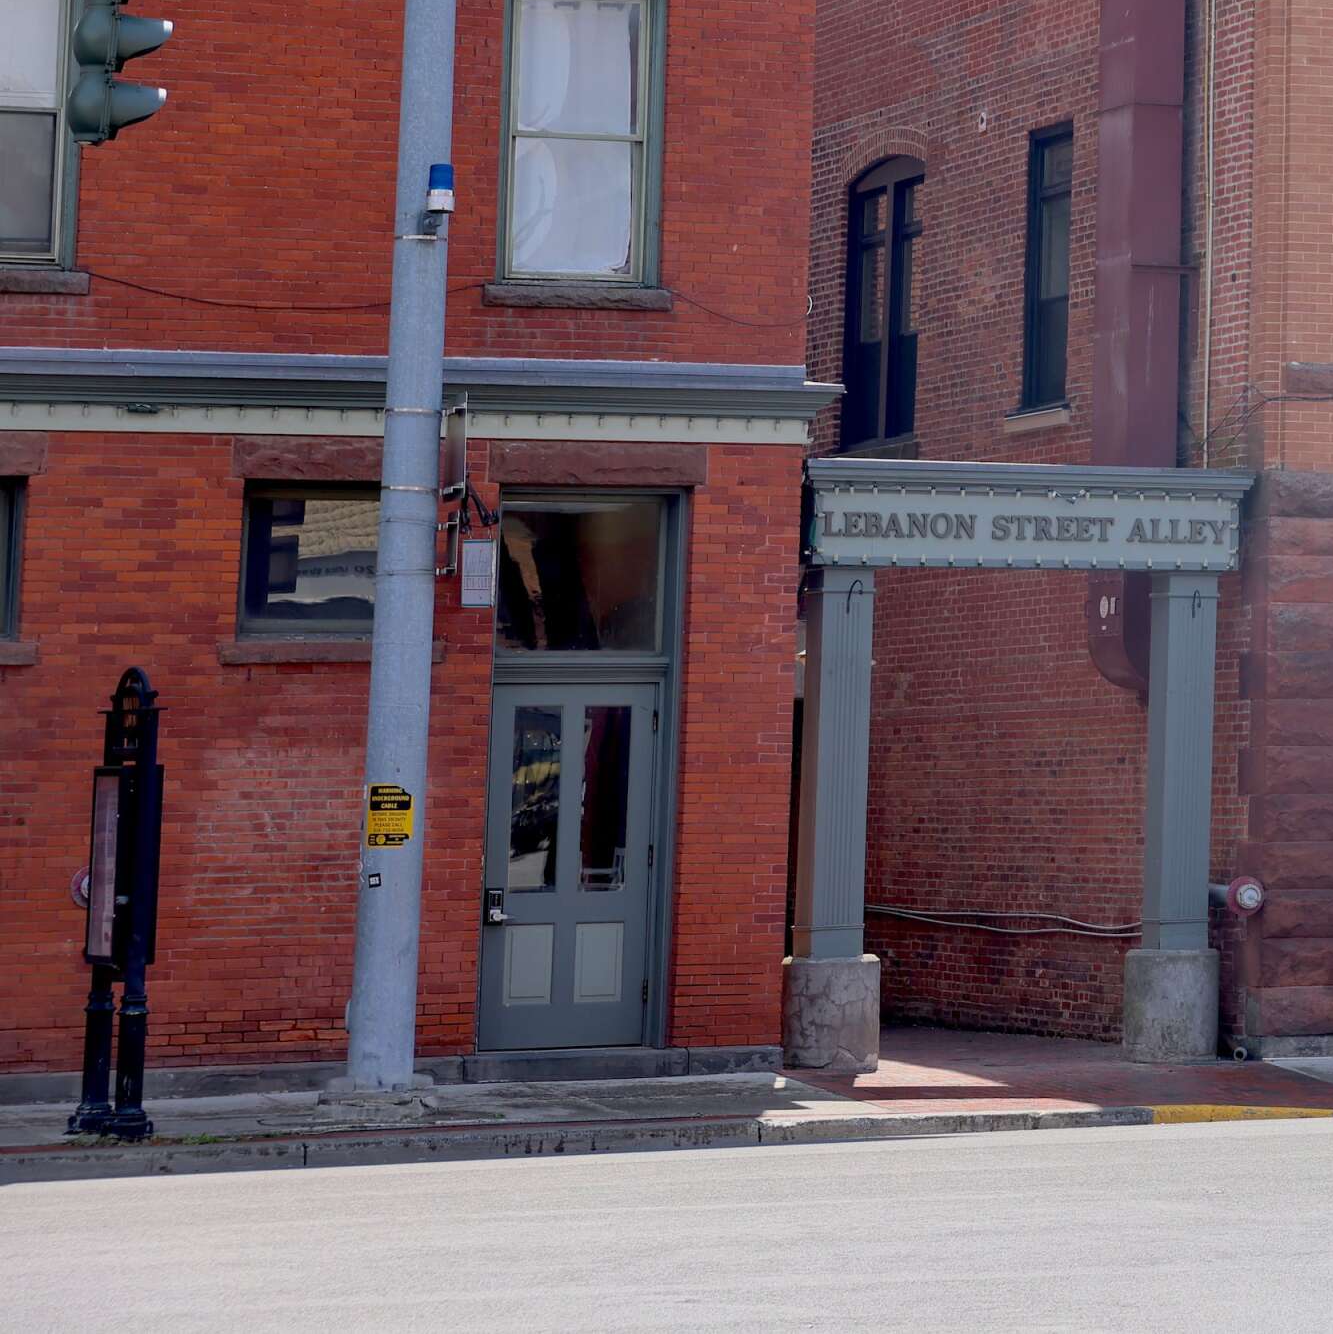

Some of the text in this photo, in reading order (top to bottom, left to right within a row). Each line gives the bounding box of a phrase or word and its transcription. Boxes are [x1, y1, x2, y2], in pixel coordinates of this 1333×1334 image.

[822, 511, 1230, 545] LEBANON STREET ALLEY
